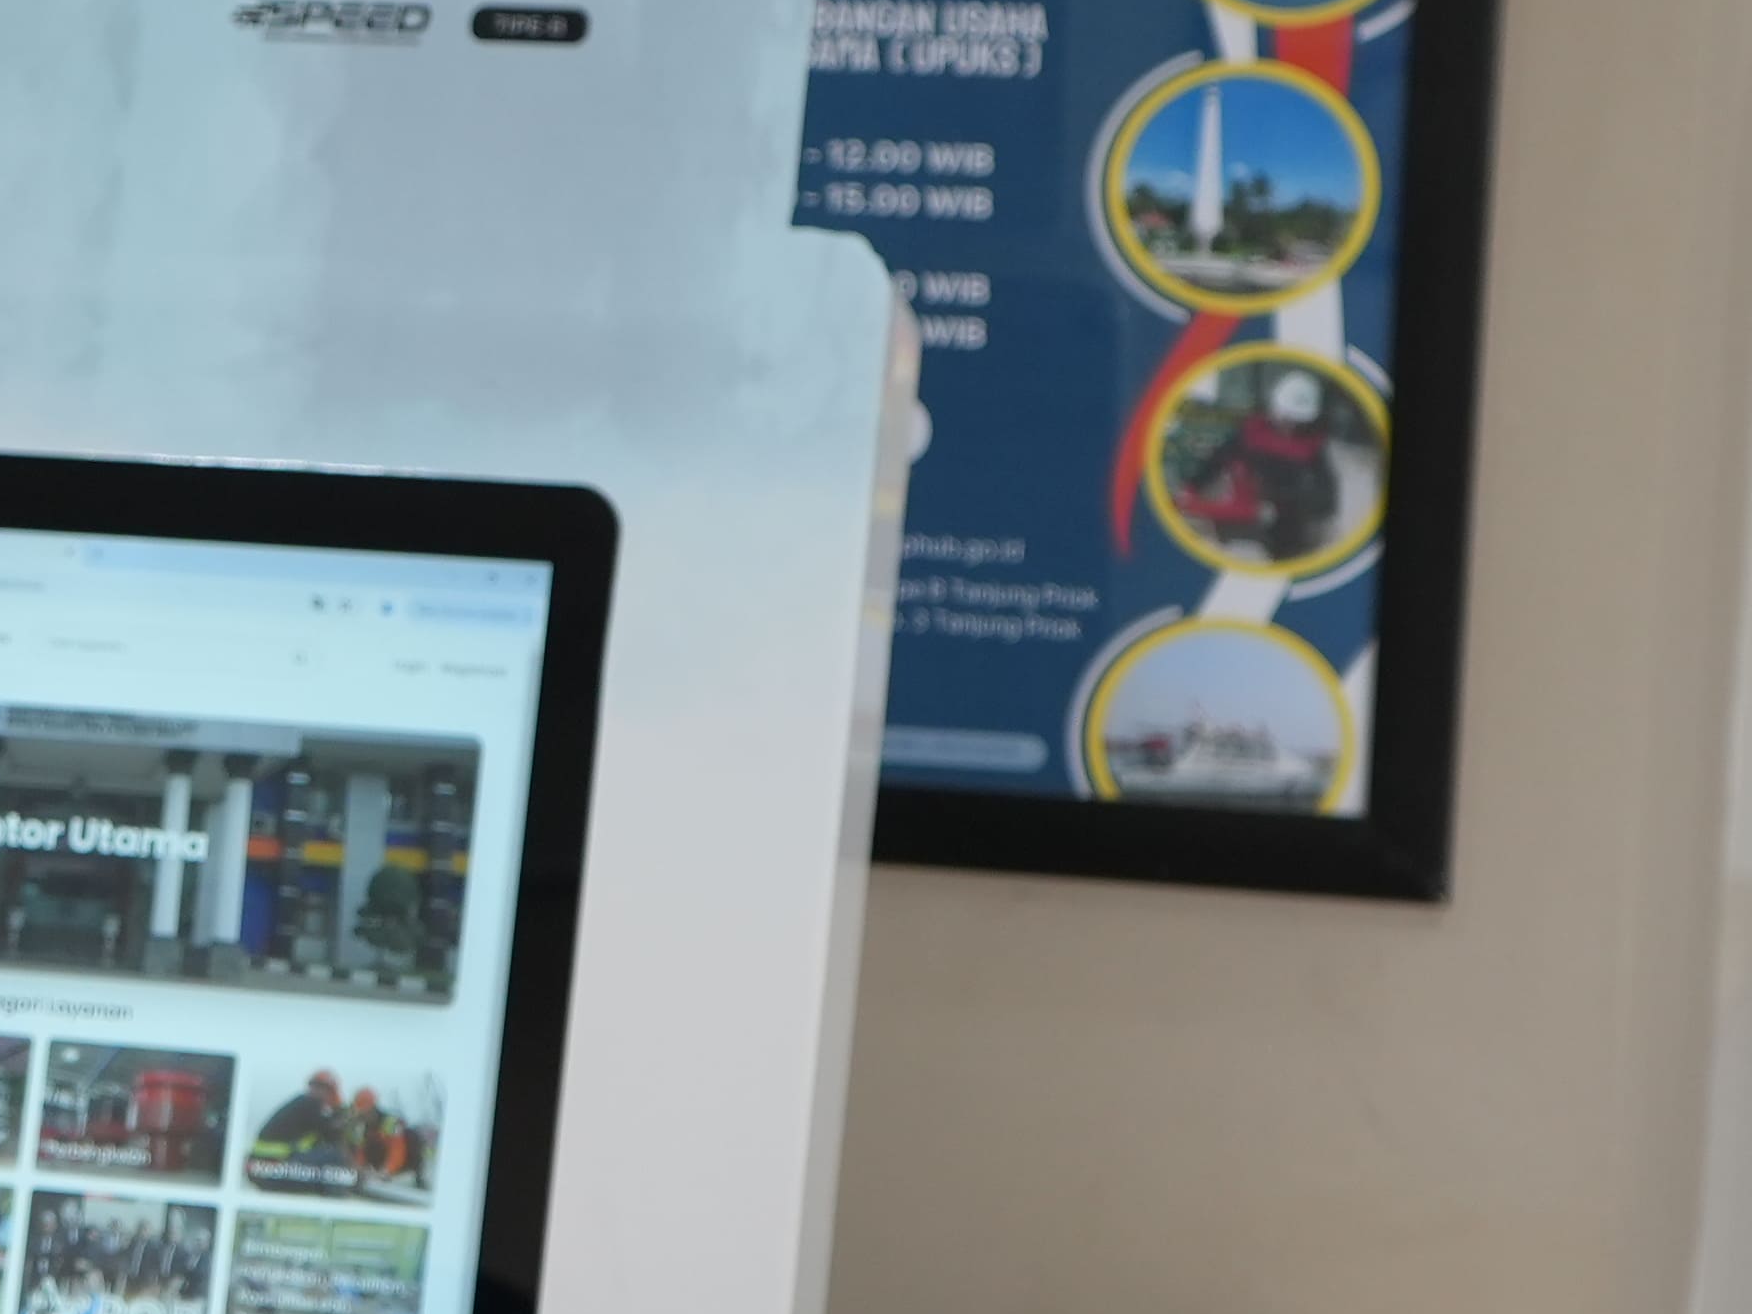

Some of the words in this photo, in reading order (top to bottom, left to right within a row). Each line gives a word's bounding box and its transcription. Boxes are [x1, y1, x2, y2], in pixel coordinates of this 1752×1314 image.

[825, 139, 923, 175] 12.00
[924, 142, 995, 178] WIB
[825, 182, 922, 218] 15.00
[923, 185, 994, 221] WIB
[920, 271, 992, 308] WIB
[69, 817, 209, 862] Utama
